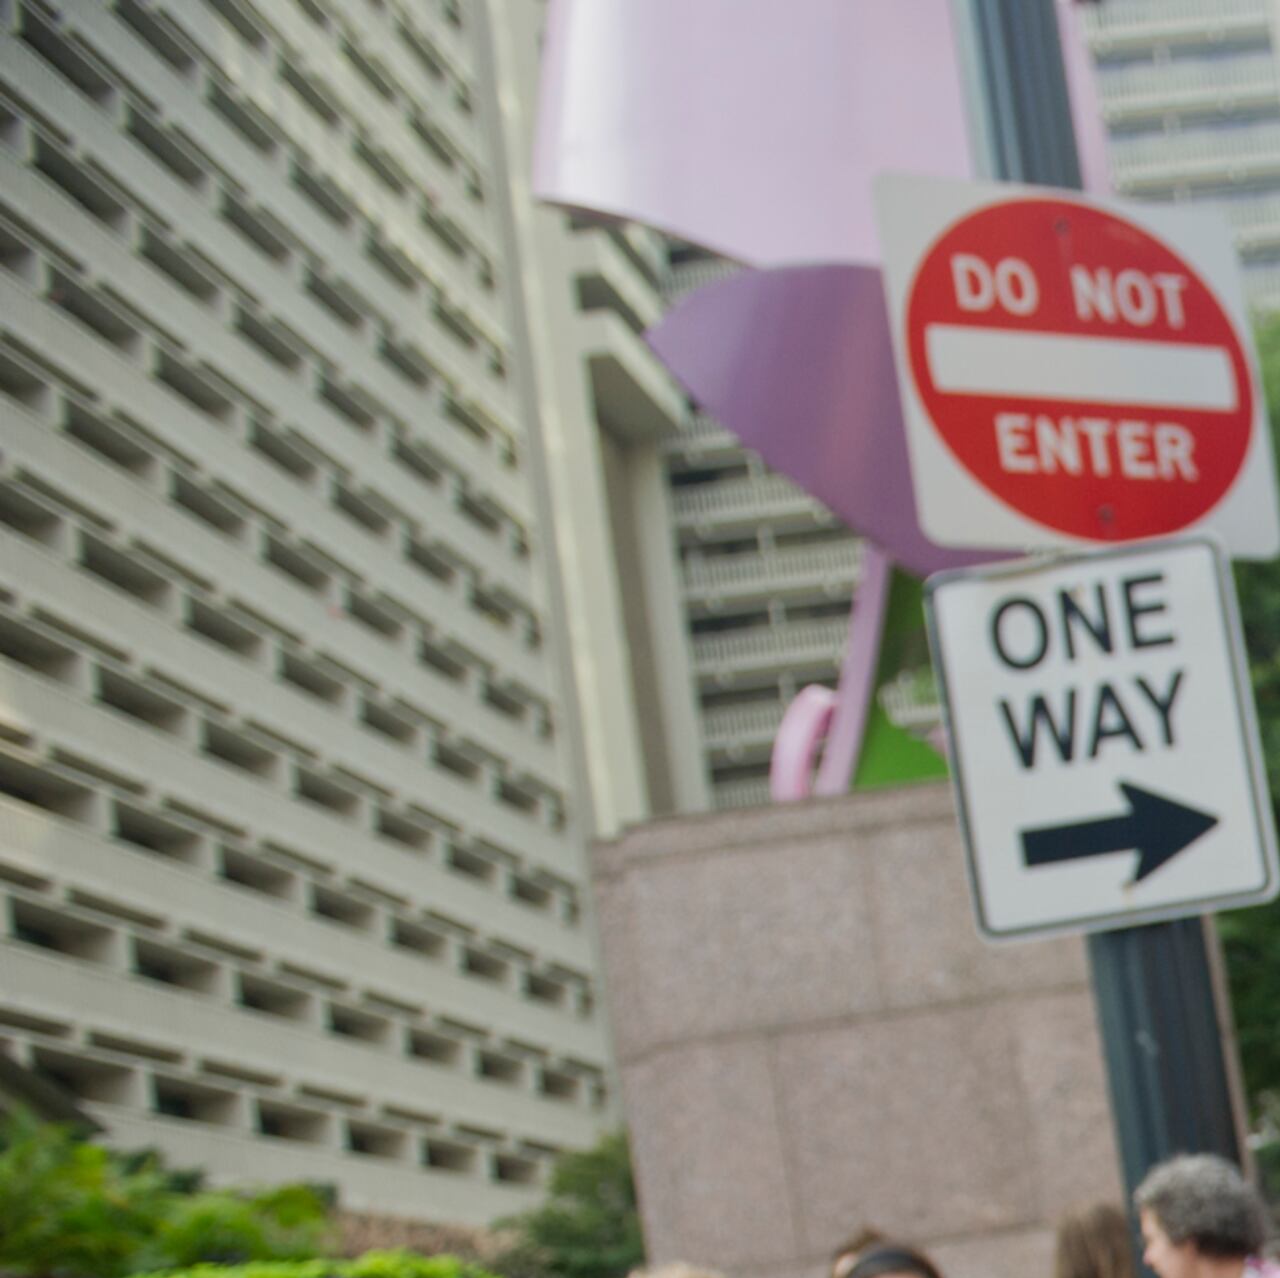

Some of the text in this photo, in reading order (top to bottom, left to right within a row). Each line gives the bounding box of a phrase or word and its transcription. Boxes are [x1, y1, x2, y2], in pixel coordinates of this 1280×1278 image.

[951, 254, 1187, 329] DO NOT
[994, 412, 1198, 481] ENTER
[991, 572, 1175, 670] ONE
[1000, 671, 1184, 769] WAY
